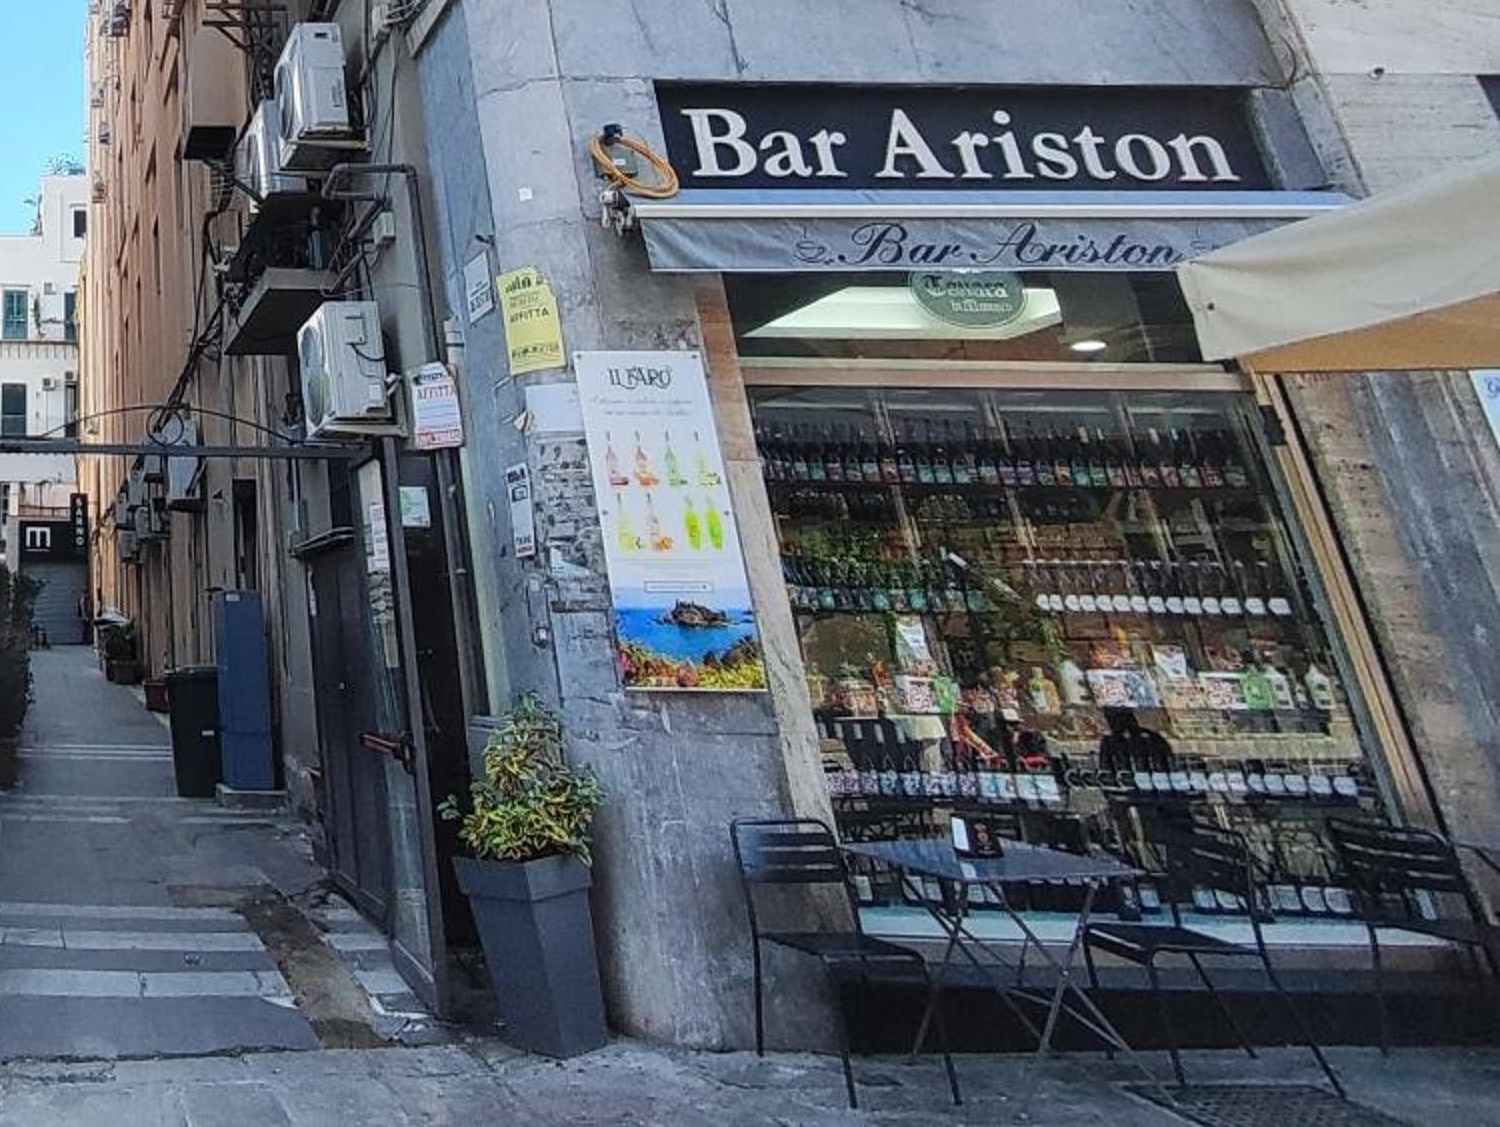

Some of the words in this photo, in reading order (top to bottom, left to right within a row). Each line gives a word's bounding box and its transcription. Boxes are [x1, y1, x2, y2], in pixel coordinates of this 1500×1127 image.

[681, 108, 849, 179] Bar
[875, 108, 1241, 182] Ariston
[837, 222, 962, 265] Bar
[970, 222, 1184, 265] Ariston
[625, 365, 672, 390] FARO
